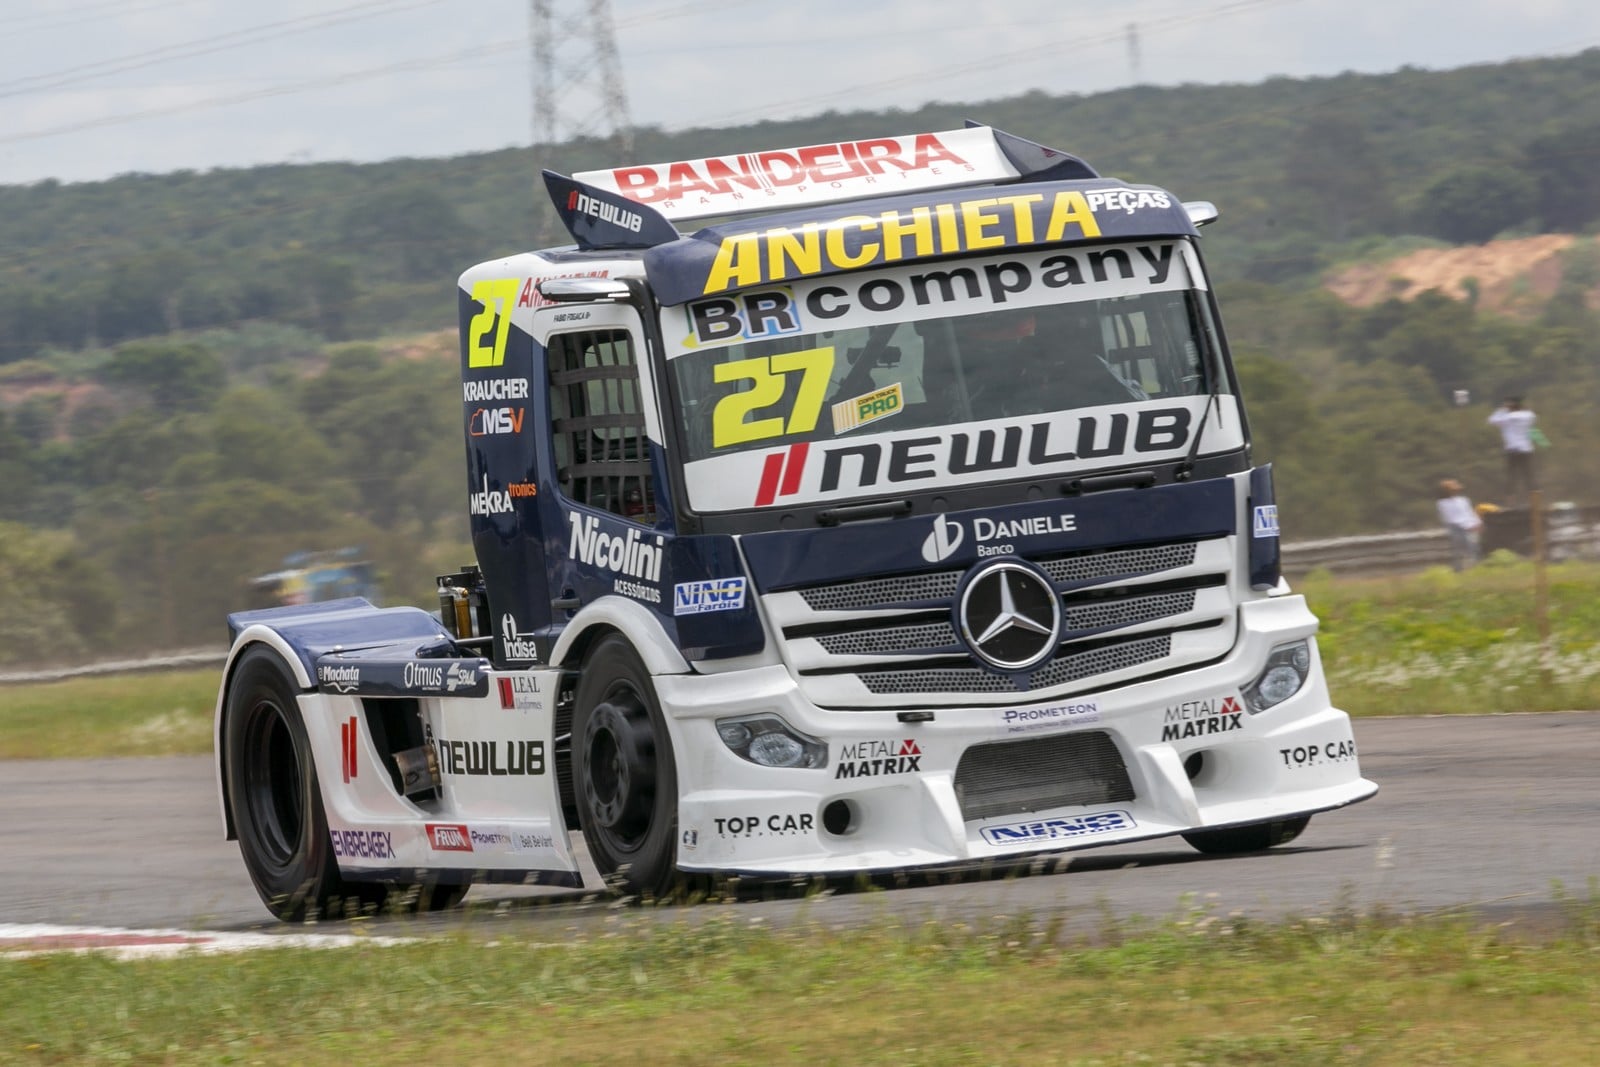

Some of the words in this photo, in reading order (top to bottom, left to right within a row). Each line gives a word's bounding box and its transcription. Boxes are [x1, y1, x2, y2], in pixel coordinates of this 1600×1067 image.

[613, 133, 968, 204] BANDEIRA
[577, 193, 643, 233] NEWLUB
[703, 191, 1102, 295] ANCHIETA
[1085, 191, 1172, 215] PEÇAS
[690, 291, 798, 342] BR
[807, 245, 1174, 320] company
[469, 278, 521, 368] 27
[464, 378, 528, 402] KRAUCHER
[713, 347, 835, 448] 27
[482, 407, 525, 434] MSV
[859, 394, 898, 419] PRO
[819, 407, 1193, 493] NEWLUB
[471, 472, 514, 518] MEKRA
[508, 478, 537, 498] tronics
[973, 514, 1077, 542] DANIELE
[569, 511, 664, 583] Nicolini
[977, 544, 1015, 557] Banco
[404, 662, 442, 688] Otmus
[1002, 703, 1097, 723] PROMETEON
[1164, 699, 1219, 723] METAL
[1161, 713, 1244, 742] MATRIX
[439, 740, 546, 775] NEWLUB
[840, 741, 898, 760] METAL
[1280, 746, 1319, 765] TOP
[1325, 740, 1357, 758] CAR
[835, 756, 922, 779] MATRIX
[434, 827, 467, 848] FRUM
[714, 817, 760, 834] TOP
[767, 813, 814, 831] CAR
[330, 829, 396, 859] EMBREAGEX
